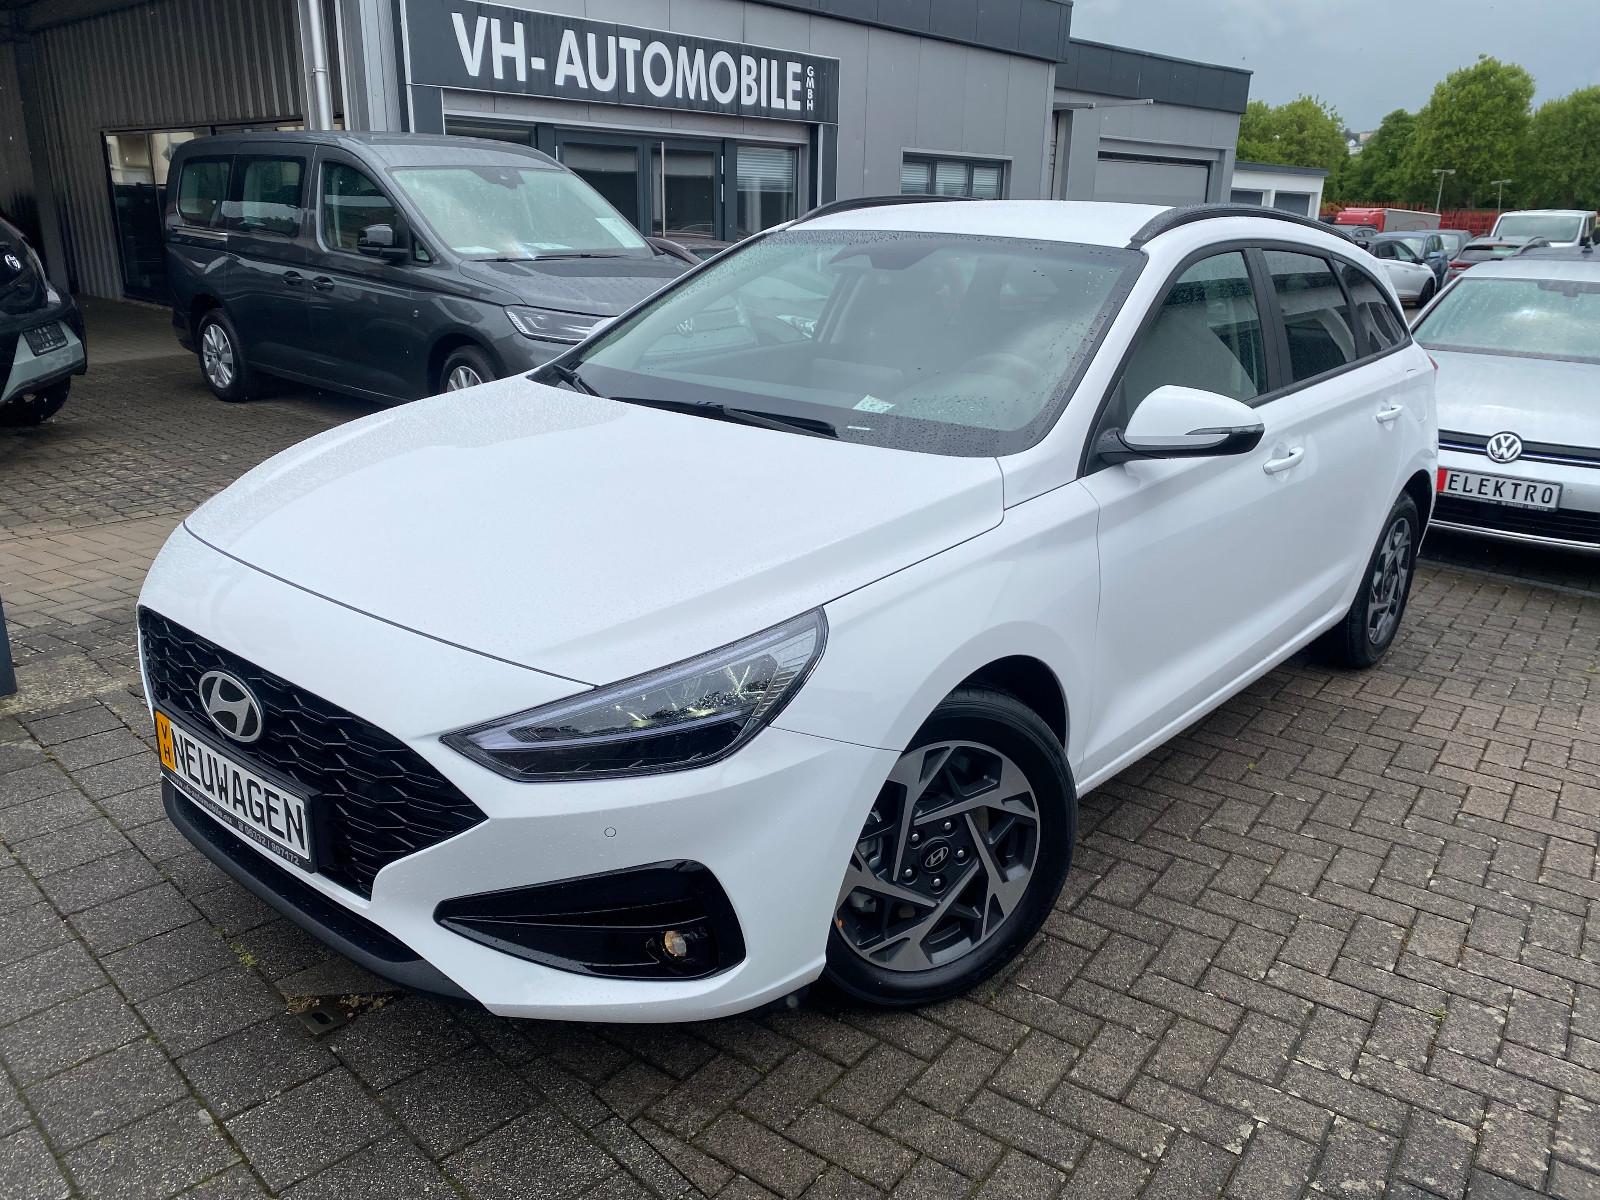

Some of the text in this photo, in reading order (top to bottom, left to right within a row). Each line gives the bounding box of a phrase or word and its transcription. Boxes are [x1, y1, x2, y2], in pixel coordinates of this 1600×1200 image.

[806, 65, 815, 111] GMBH
[1448, 473, 1553, 504] ELEKTRO
[170, 728, 305, 850] NEUWAGEN
